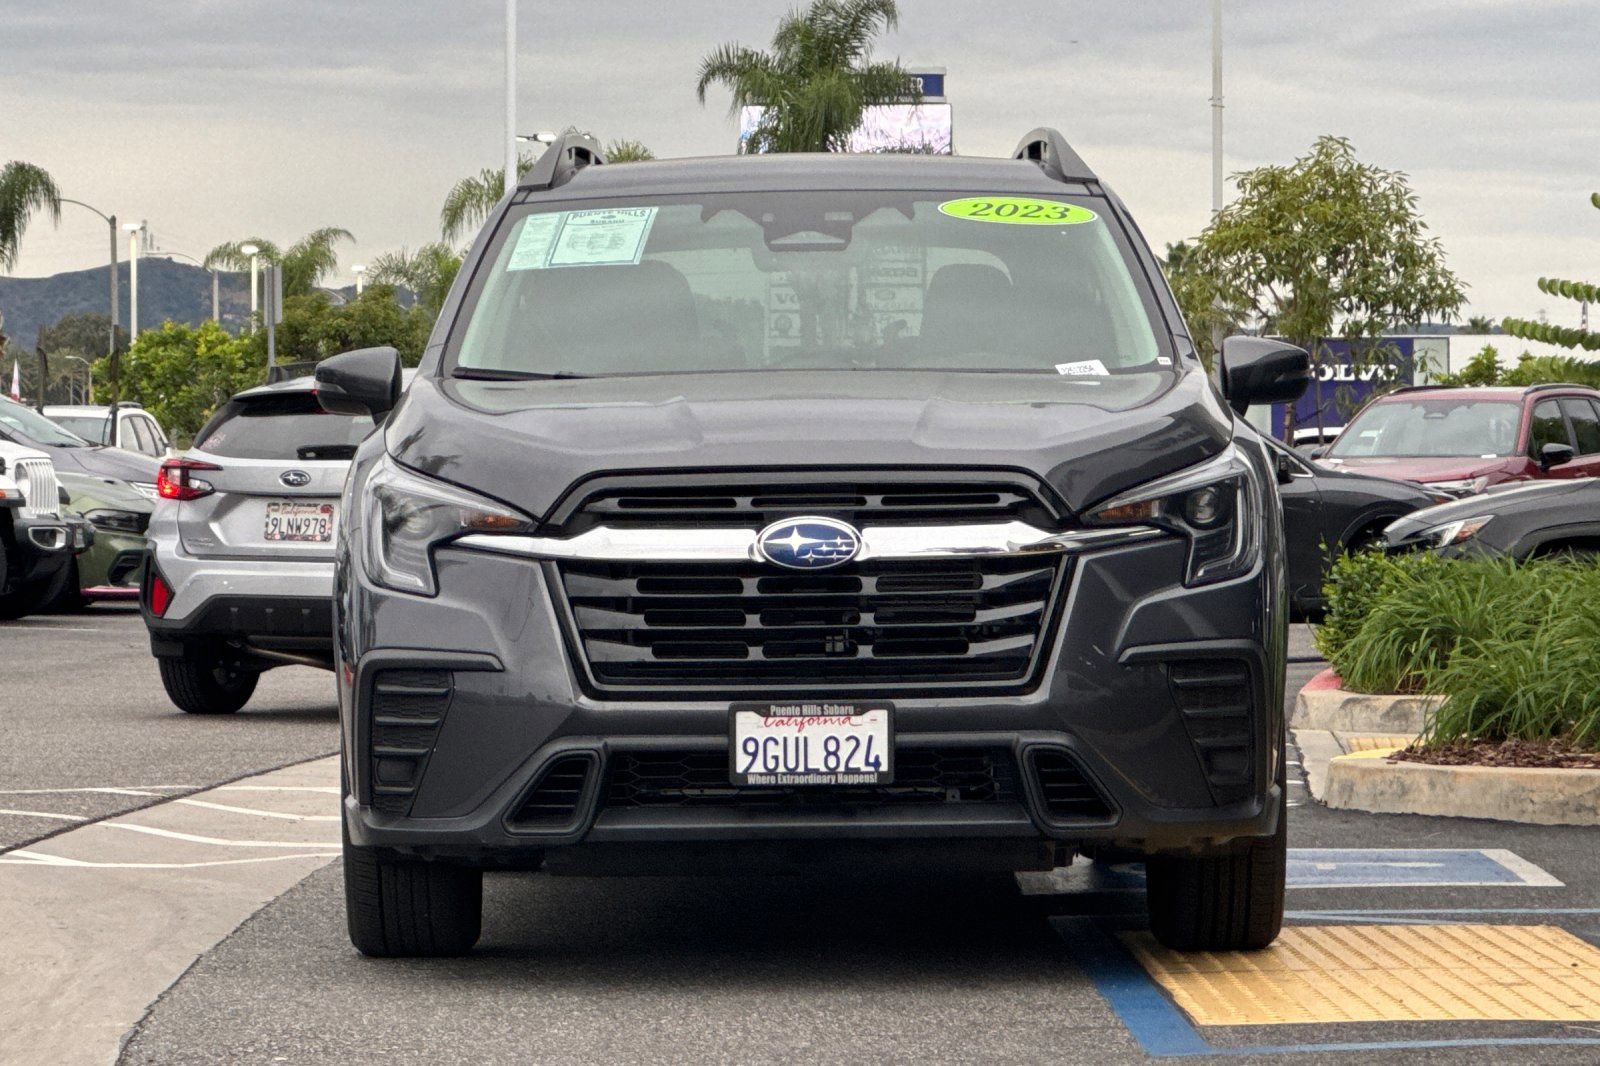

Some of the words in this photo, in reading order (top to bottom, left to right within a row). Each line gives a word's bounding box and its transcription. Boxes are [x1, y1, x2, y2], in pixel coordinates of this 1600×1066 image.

[968, 202, 1071, 220] 2023
[1309, 363, 1399, 382] OLVO
[271, 517, 327, 535] 9LNW978
[770, 705, 801, 716] Puente
[802, 705, 823, 716] Hills
[823, 704, 855, 715] Subaru
[761, 715, 863, 733] California
[742, 735, 882, 773] 9GUL824
[747, 773, 776, 785] Where
[777, 773, 836, 785] Extraordinary
[837, 773, 878, 785] Happens!
